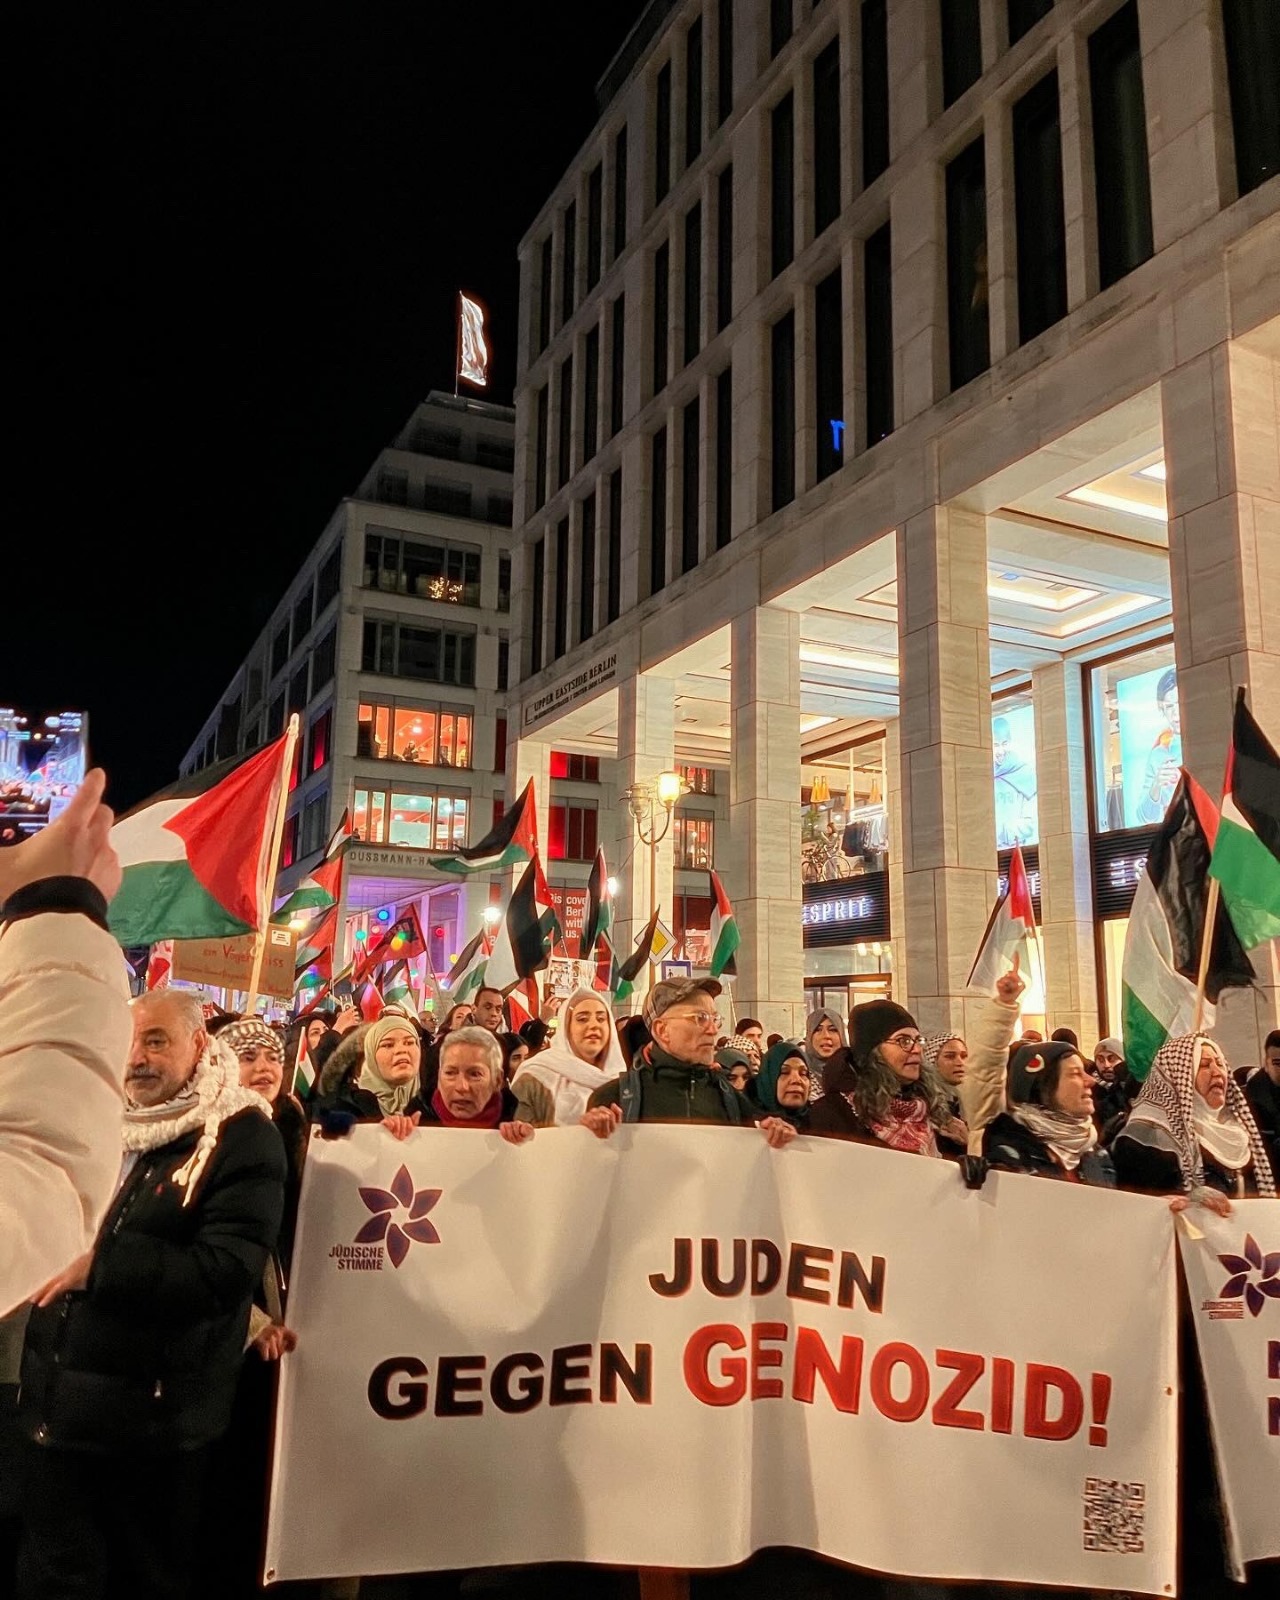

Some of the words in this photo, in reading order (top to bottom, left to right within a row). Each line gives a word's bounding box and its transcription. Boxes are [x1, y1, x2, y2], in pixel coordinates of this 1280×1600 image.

[533, 693, 554, 712] UPPER
[556, 672, 588, 699] EASTSIDE
[589, 654, 617, 680] BERLIN
[350, 851, 431, 866] DUSSMANN-HA
[565, 930, 580, 938] us.
[328, 1243, 384, 1258] JÜDISCHE
[337, 1259, 383, 1270] STIMME
[648, 1238, 886, 1313] JUDEN
[367, 1342, 653, 1421] GEGEN
[683, 1322, 1112, 1447] GENOZID!
